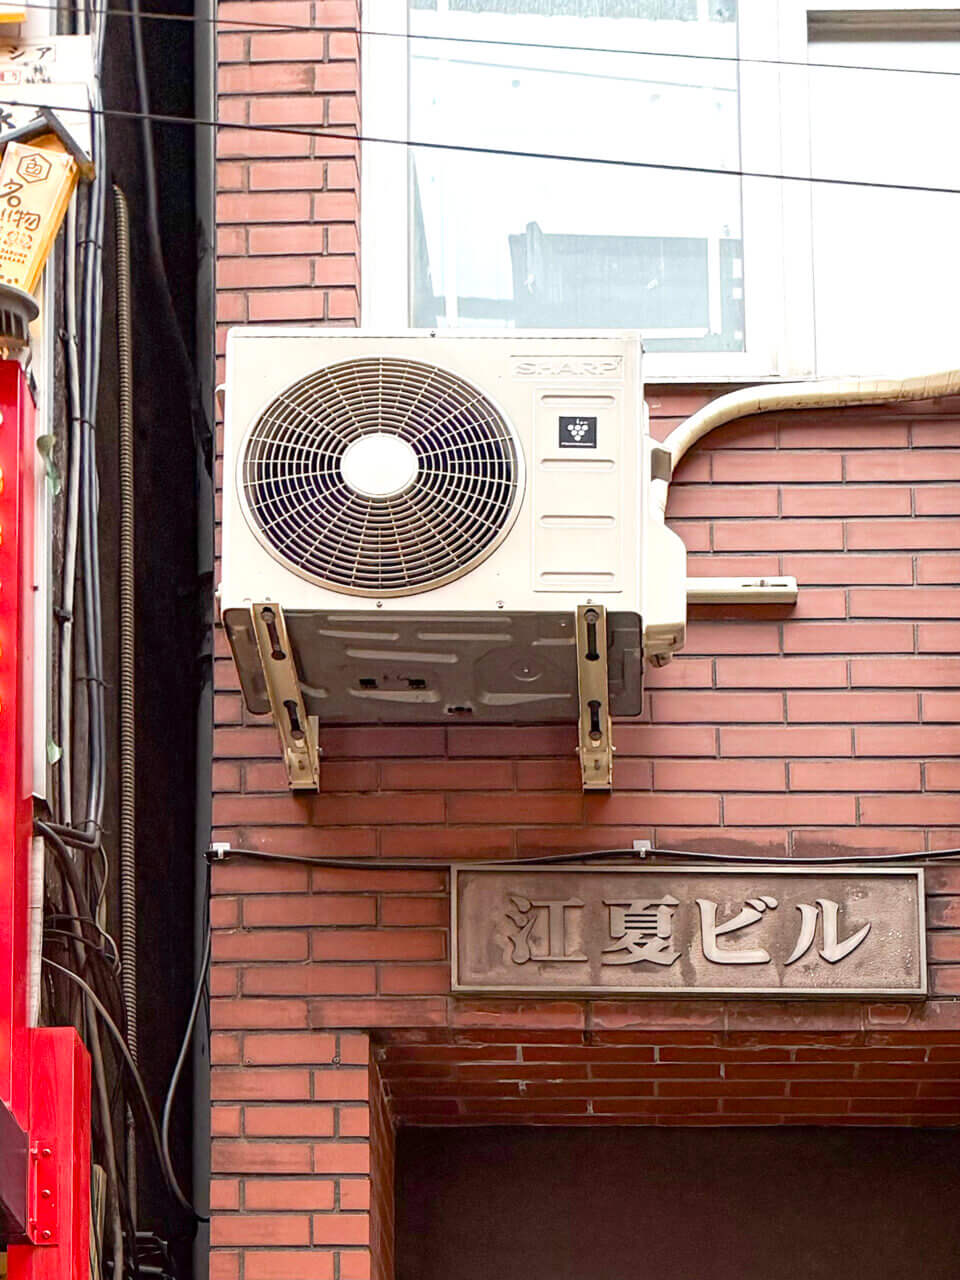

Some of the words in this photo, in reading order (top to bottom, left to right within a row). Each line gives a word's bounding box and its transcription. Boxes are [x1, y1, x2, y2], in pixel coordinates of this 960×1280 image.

[515, 362, 619, 376] SHARP
[504, 894, 873, 967] 江夏ビル
